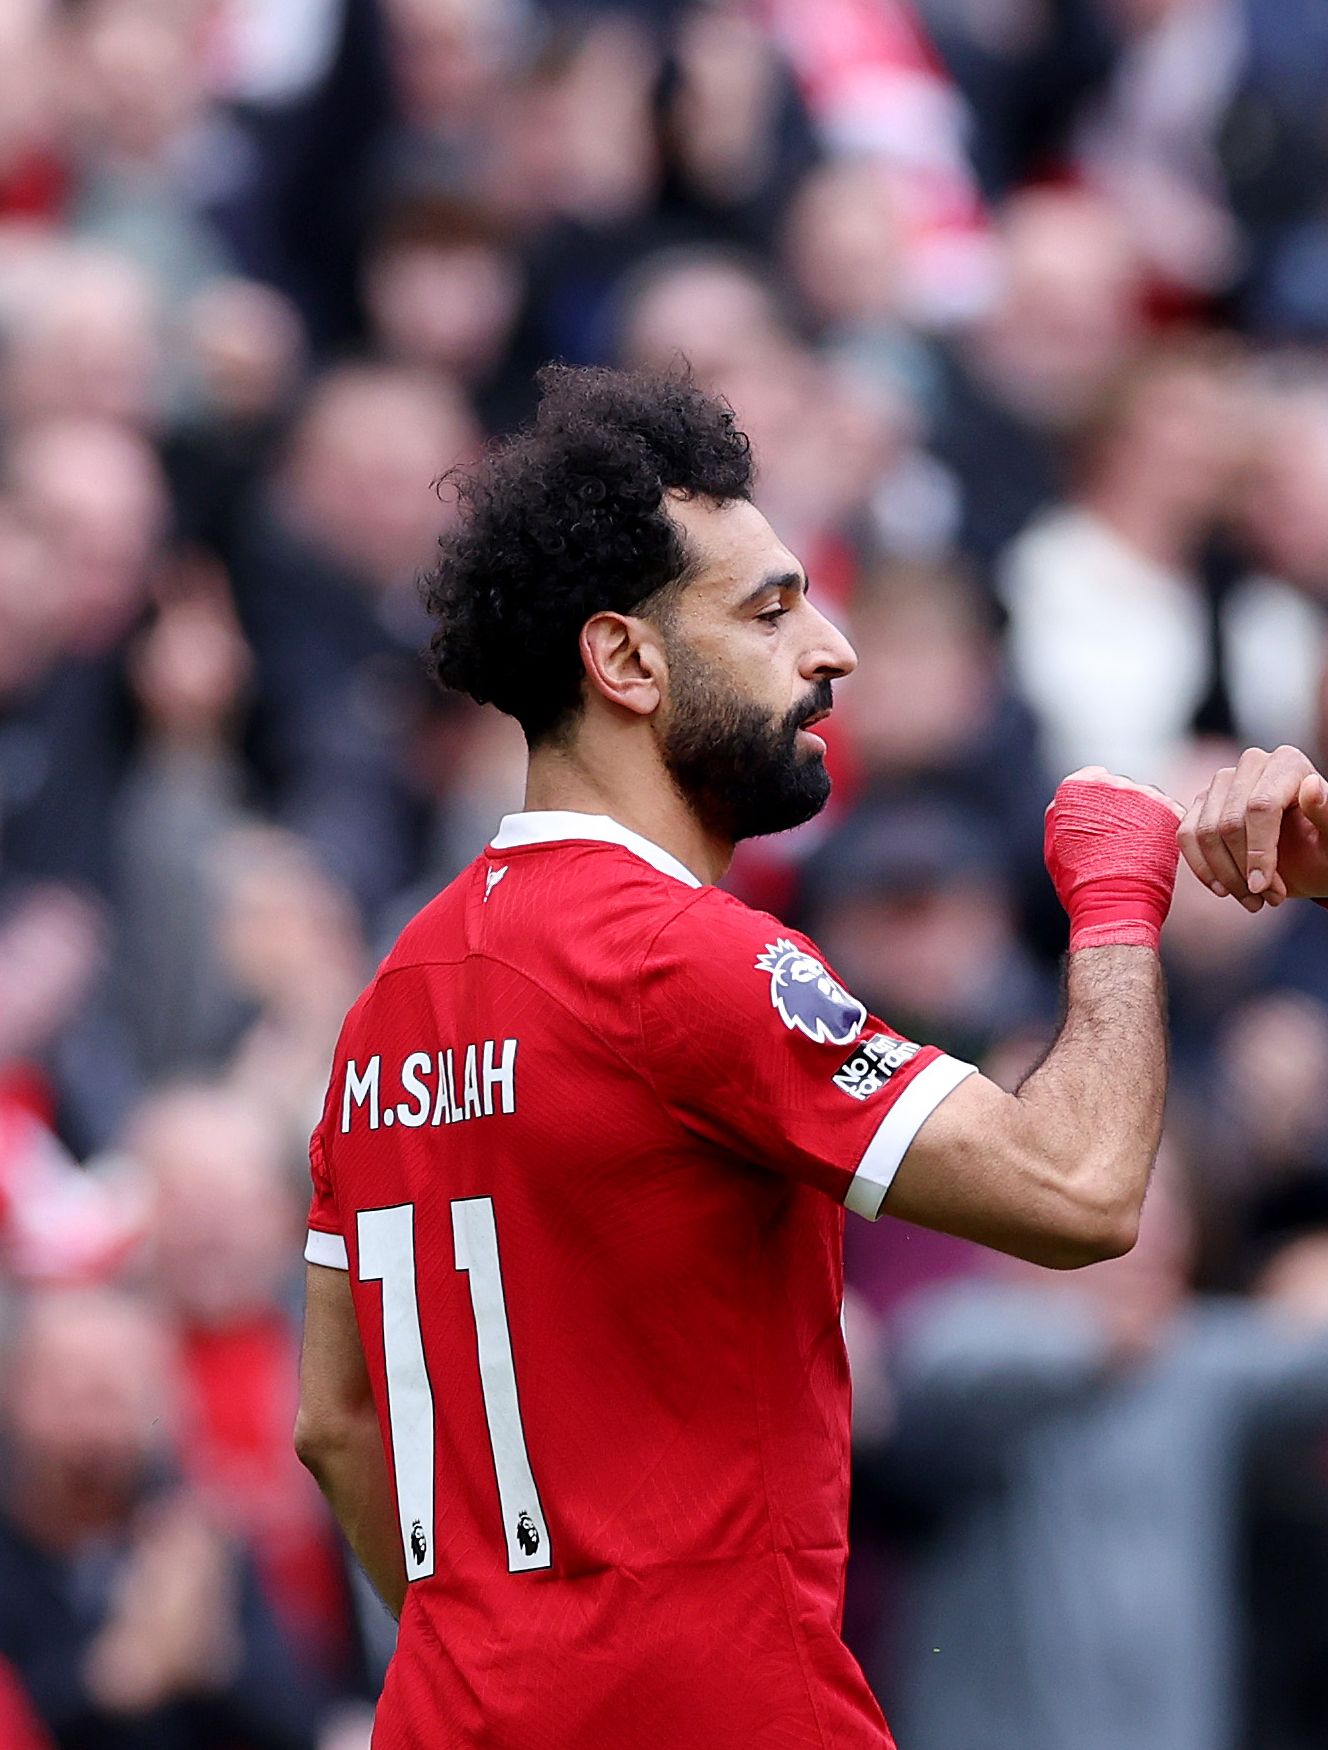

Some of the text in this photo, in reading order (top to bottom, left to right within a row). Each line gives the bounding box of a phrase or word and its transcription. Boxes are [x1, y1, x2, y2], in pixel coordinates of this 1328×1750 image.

[341, 1038, 518, 1134] M.SALAH
[832, 1057, 869, 1092] No
[848, 1068, 883, 1100] for
[356, 1196, 552, 1582] 11
